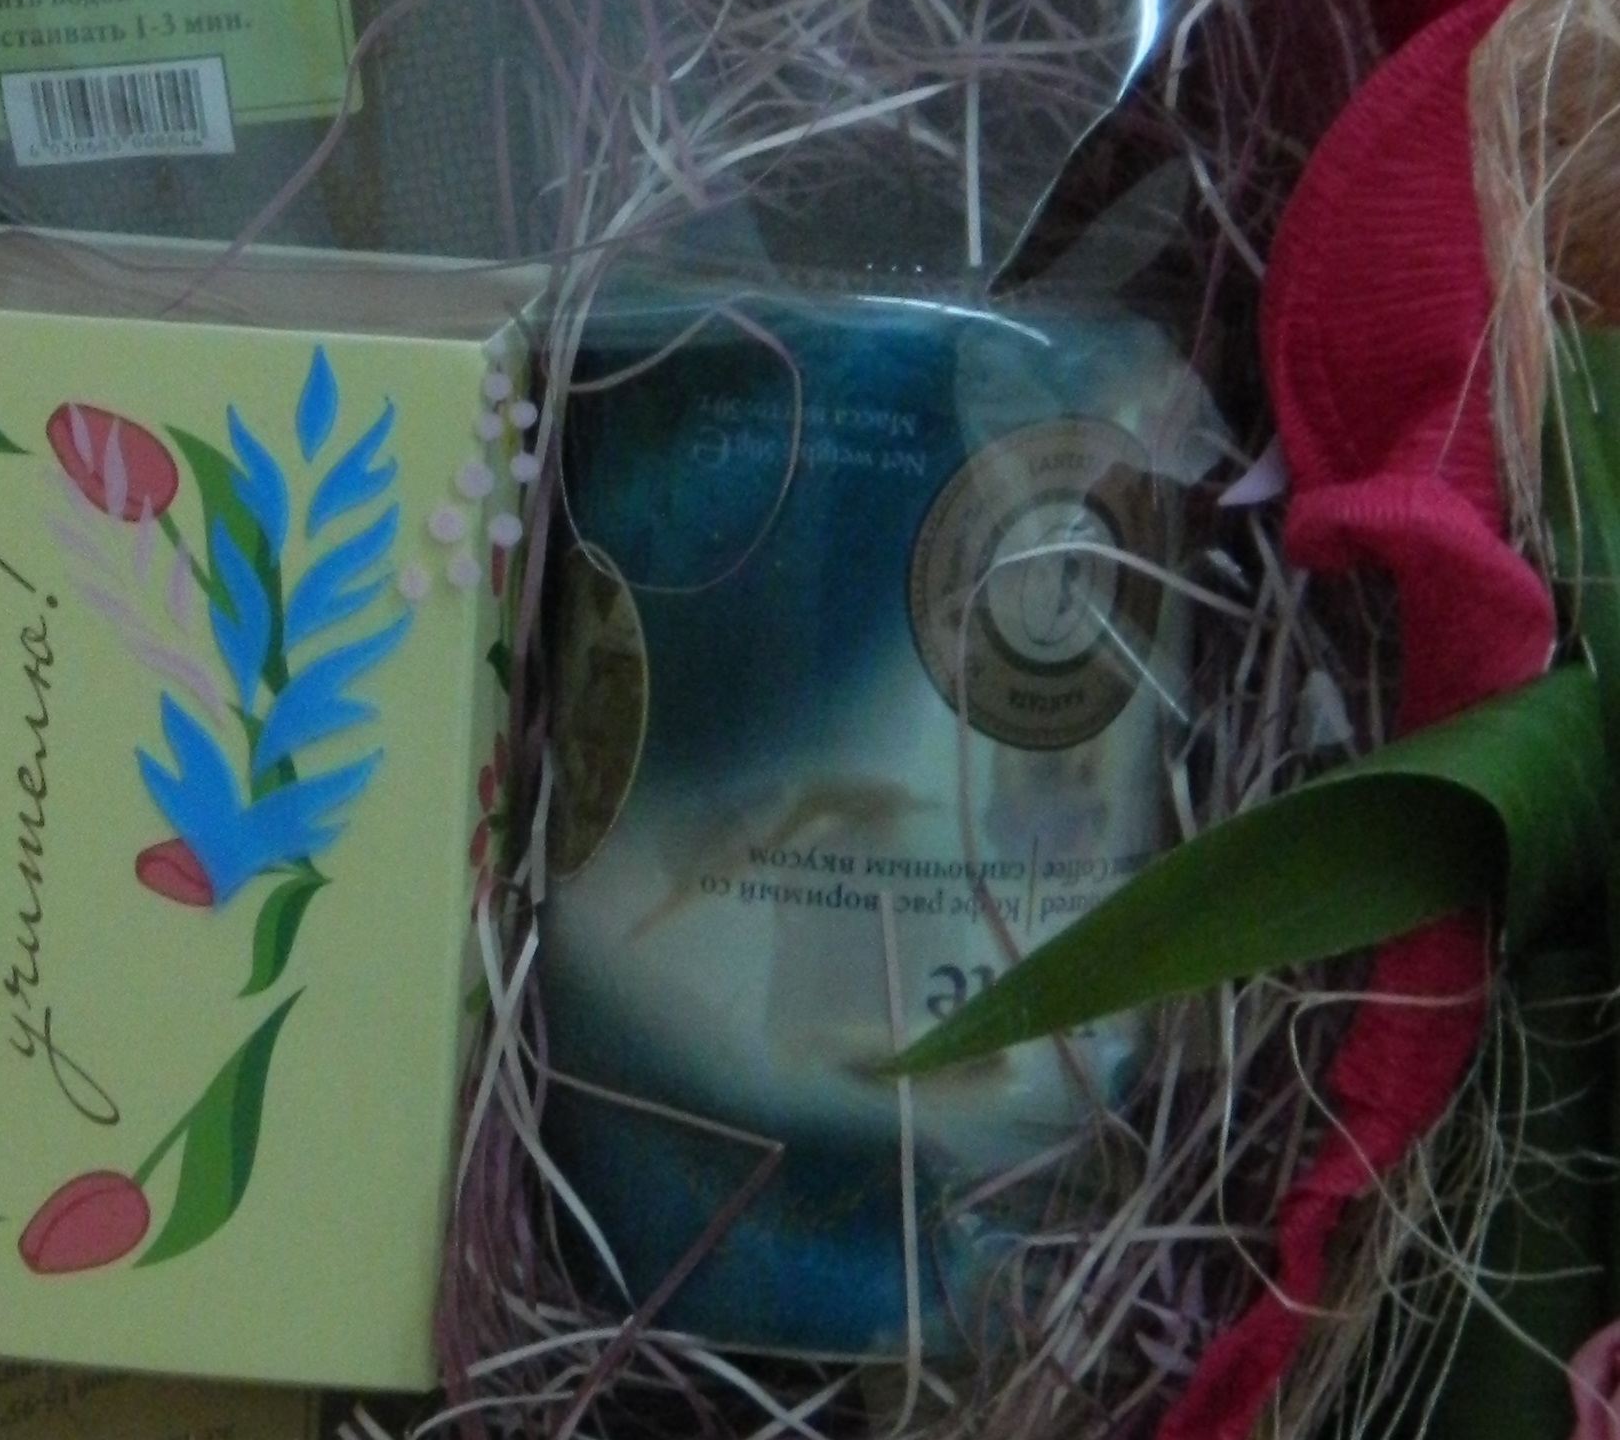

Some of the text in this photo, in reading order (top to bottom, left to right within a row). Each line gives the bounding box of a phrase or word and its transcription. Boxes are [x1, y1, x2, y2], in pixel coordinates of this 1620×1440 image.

[135, 13, 177, 39] 1-3
[184, 11, 254, 36] мин.
[745, 845, 857, 873] вкусом
[697, 873, 732, 895] со
